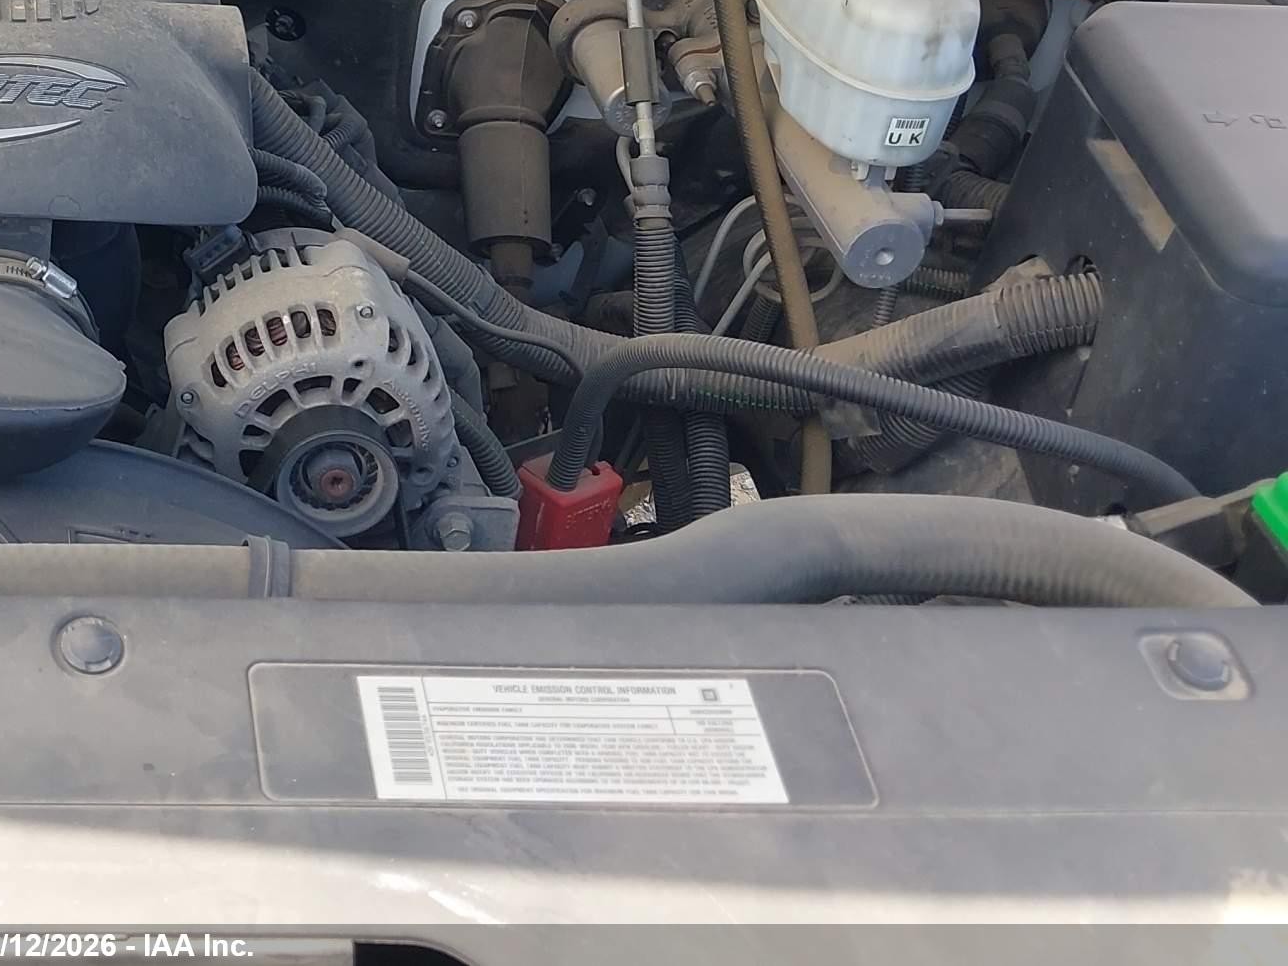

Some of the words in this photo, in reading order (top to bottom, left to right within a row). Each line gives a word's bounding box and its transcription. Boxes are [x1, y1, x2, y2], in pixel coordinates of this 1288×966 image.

[233, 361, 317, 419] DELPHI
[493, 685, 527, 694] VEHICLE
[531, 685, 572, 694] EMISSION
[575, 686, 614, 695] CONTROL
[616, 686, 677, 695] INFORMATION
